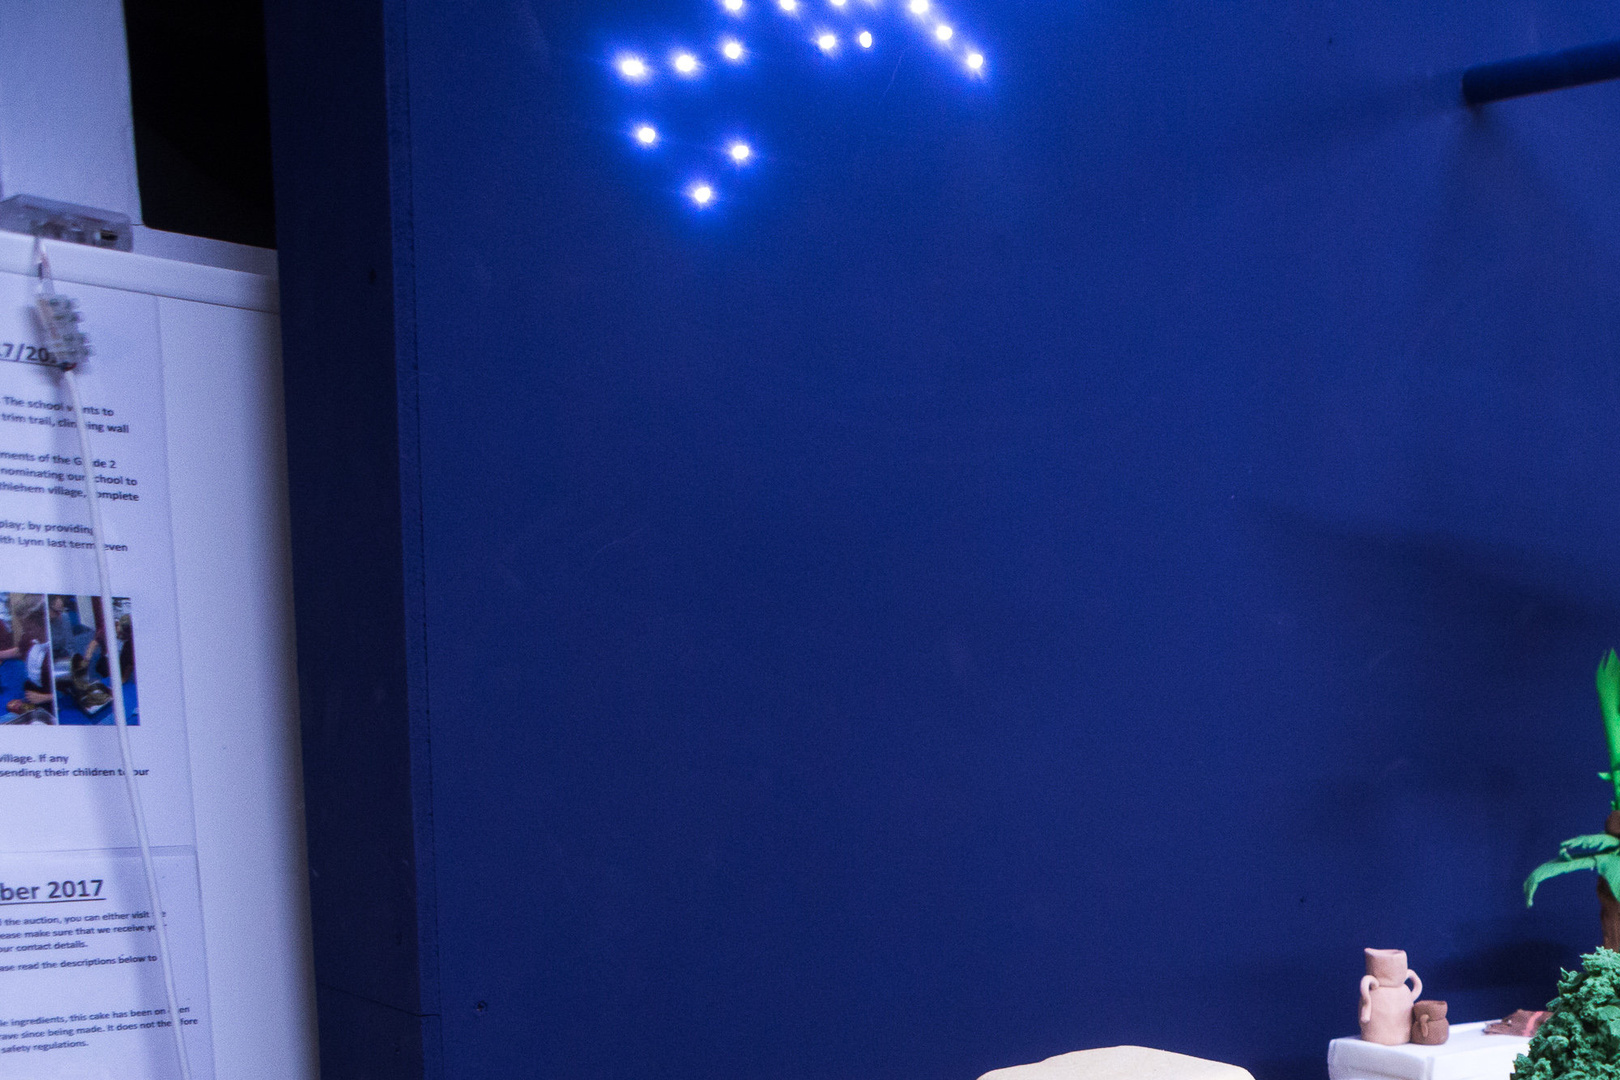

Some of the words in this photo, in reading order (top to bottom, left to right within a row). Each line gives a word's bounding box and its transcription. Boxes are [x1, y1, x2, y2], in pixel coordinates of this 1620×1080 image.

[2, 396, 25, 407] The
[28, 400, 64, 411] school
[66, 405, 100, 415] wnts
[102, 407, 115, 417] to
[1, 413, 26, 424] trim
[58, 419, 105, 433] climing
[106, 424, 130, 434] wall
[38, 454, 50, 463] of
[52, 455, 71, 466] the
[73, 456, 108, 469] Gde
[109, 460, 117, 469] 2
[0, 467, 65, 482] nominating
[93, 475, 124, 486] chool
[125, 477, 138, 487] to
[96, 491, 140, 502] omplete
[28, 521, 42, 533] by
[18, 537, 45, 548] Lynn
[47, 539, 68, 549] last
[49, 755, 70, 765] any
[44, 768, 70, 778] their
[72, 768, 116, 778] children
[0, 882, 40, 901] ber
[47, 879, 104, 899] 2017
[4, 918, 21, 926] the
[23, 916, 62, 926] auction,
[64, 915, 82, 925] you
[84, 914, 100, 923] can
[102, 912, 130, 921] either
[131, 910, 150, 919] visit
[24, 929, 51, 938] make
[52, 929, 74, 938] sure
[75, 926, 96, 936] that
[97, 926, 111, 935] we
[113, 923, 147, 933] receive
[16, 942, 51, 952] contact
[53, 940, 89, 951] details.
[18, 962, 39, 971] read
[42, 960, 58, 969] the
[60, 956, 117, 969] descriptions
[118, 954, 146, 964] below
[147, 954, 158, 963] to
[11, 1014, 68, 1029] ingredients,
[70, 1012, 88, 1023] this
[89, 1011, 111, 1022] cake
[113, 1009, 129, 1019] has
[130, 1008, 152, 1018] been
[154, 1008, 167, 1016] on
[21, 1030, 46, 1039] since
[47, 1028, 75, 1039] being
[77, 1025, 106, 1036] made.
[116, 1022, 138, 1032] does
[140, 1021, 156, 1030] not
[33, 1040, 90, 1053] regulations.
